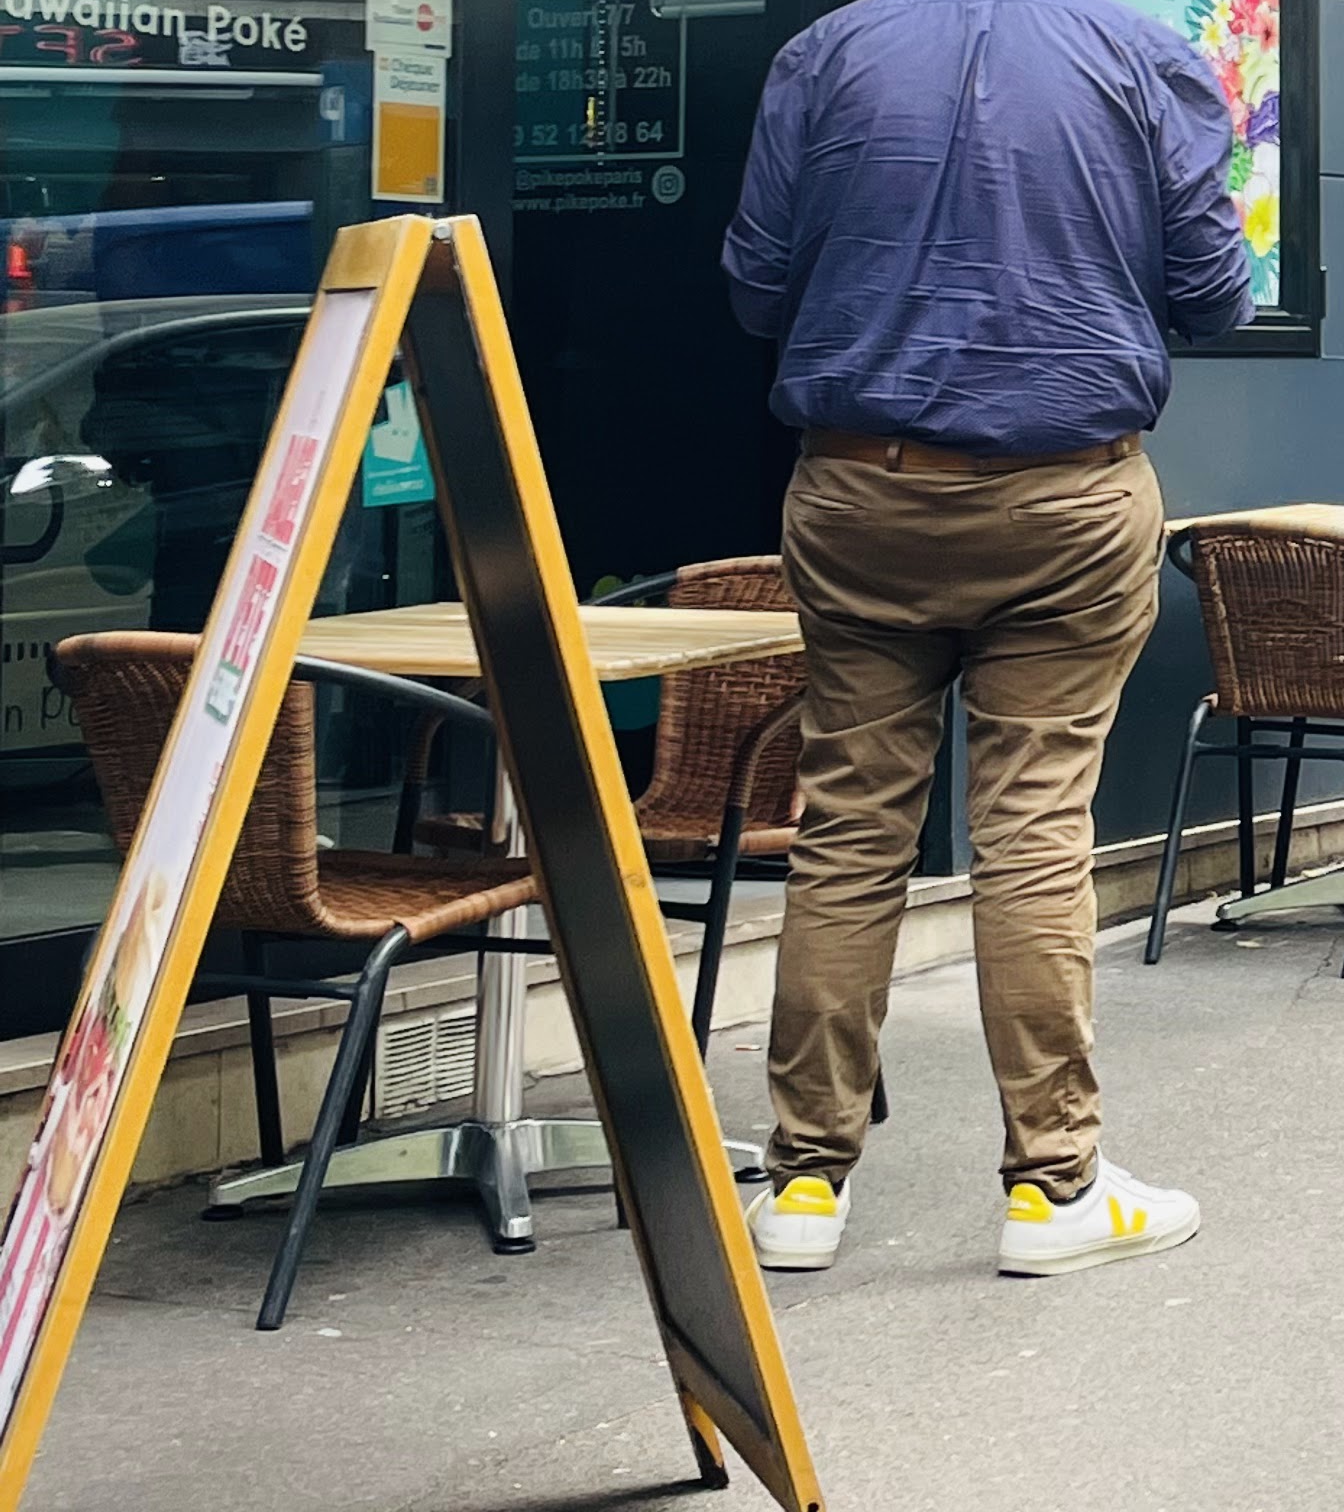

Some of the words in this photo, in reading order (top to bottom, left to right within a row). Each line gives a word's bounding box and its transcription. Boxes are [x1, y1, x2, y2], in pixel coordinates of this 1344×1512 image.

[208, 4, 308, 52] Poké
[633, 66, 672, 88] 22h
[635, 119, 664, 143] 64
